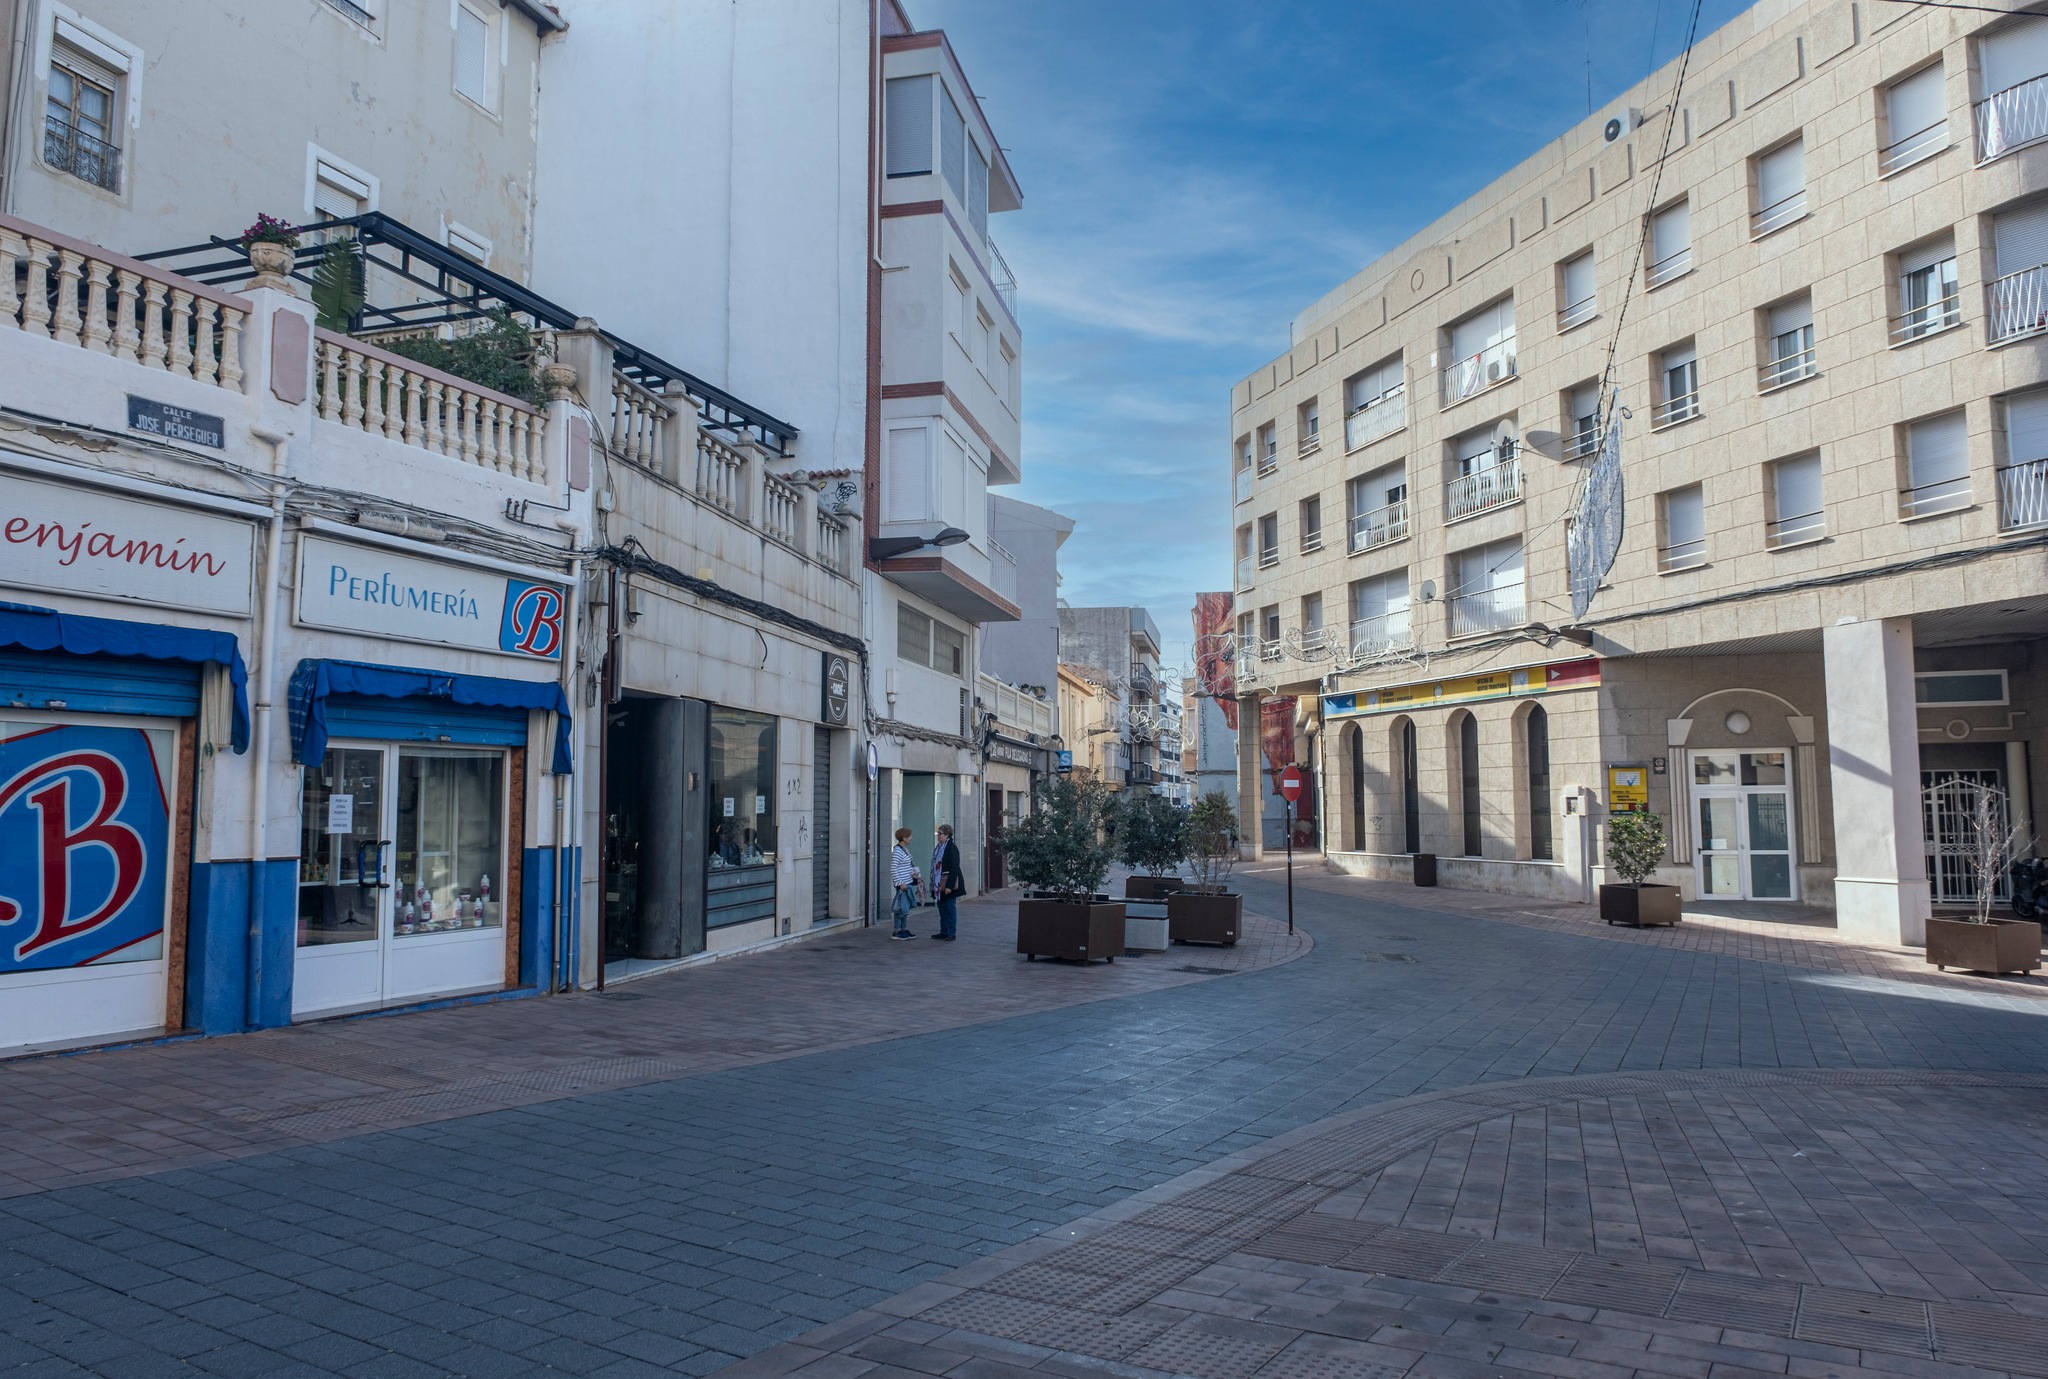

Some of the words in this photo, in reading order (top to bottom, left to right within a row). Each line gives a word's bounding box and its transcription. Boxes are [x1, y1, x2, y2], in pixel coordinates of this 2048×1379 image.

[163, 406, 192, 420] CALLE
[136, 414, 160, 433] JOSE
[164, 421, 218, 447] PERSEGUER
[511, 585, 563, 657] B
[1061, 753, 1071, 766] S
[0, 748, 148, 963] B
